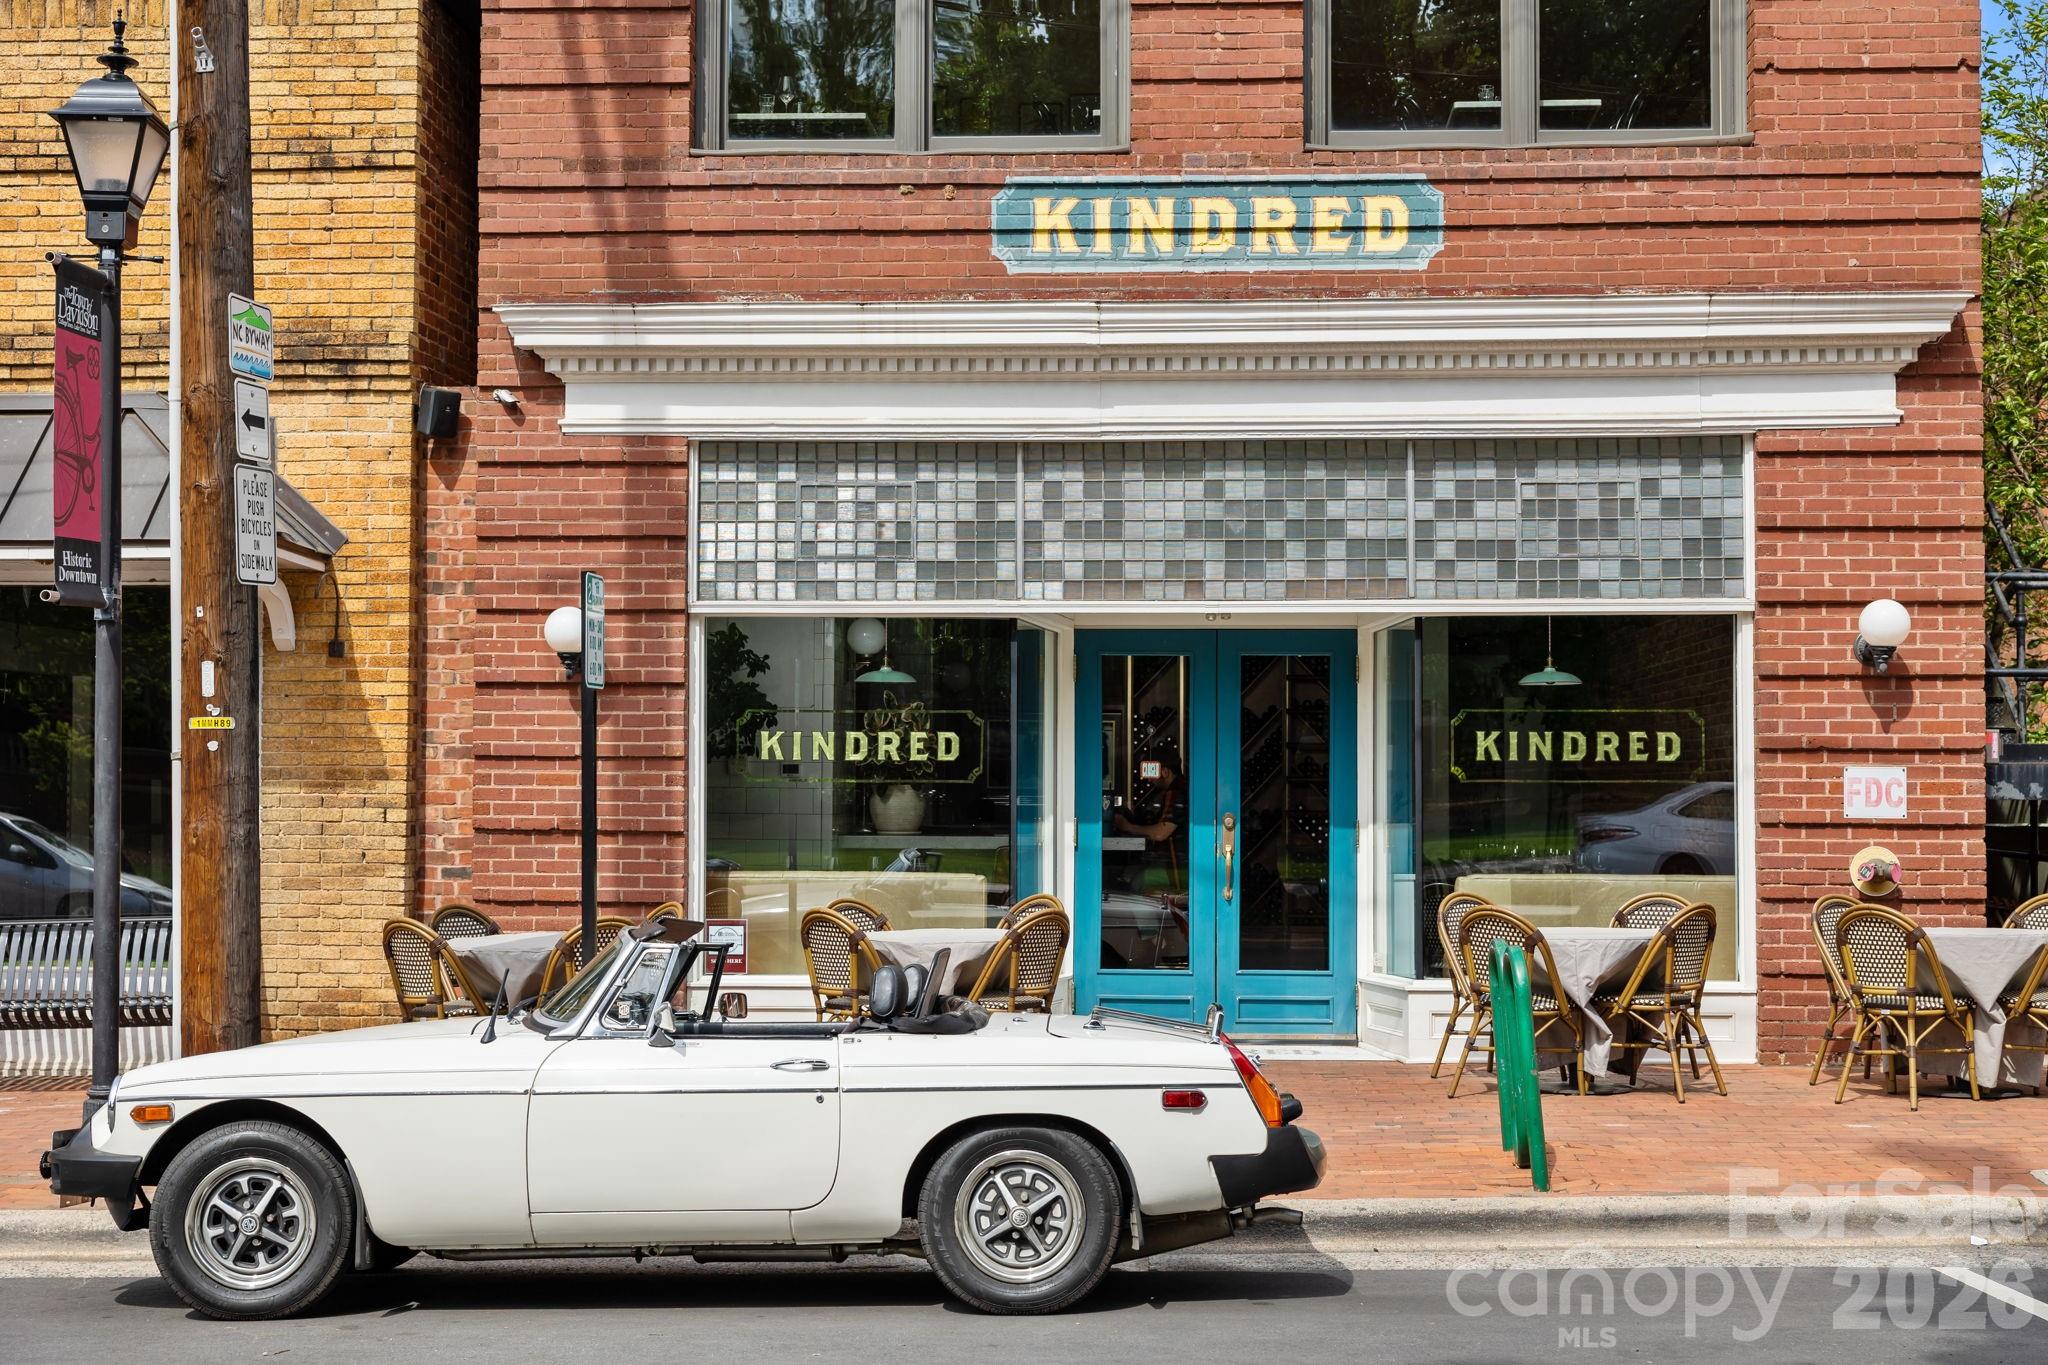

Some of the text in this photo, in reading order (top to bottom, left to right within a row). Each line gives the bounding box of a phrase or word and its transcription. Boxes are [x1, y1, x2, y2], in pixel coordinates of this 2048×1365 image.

[1029, 195, 1411, 256] KINDRED
[70, 285, 89, 312] Town
[58, 294, 99, 331] Davidson
[232, 321, 271, 351] NC BYWAY
[242, 479, 268, 498] PLEASE
[247, 499, 265, 517] PUSH
[241, 518, 272, 537] BICYCLES
[253, 539, 261, 551] ON
[62, 550, 92, 569] Historic
[241, 553, 273, 572] SIDEWALK
[58, 565, 97, 585] Downtown
[760, 731, 960, 761] KINDRED
[1475, 731, 1682, 761] KINDRED
[1846, 777, 1904, 808] FDC
